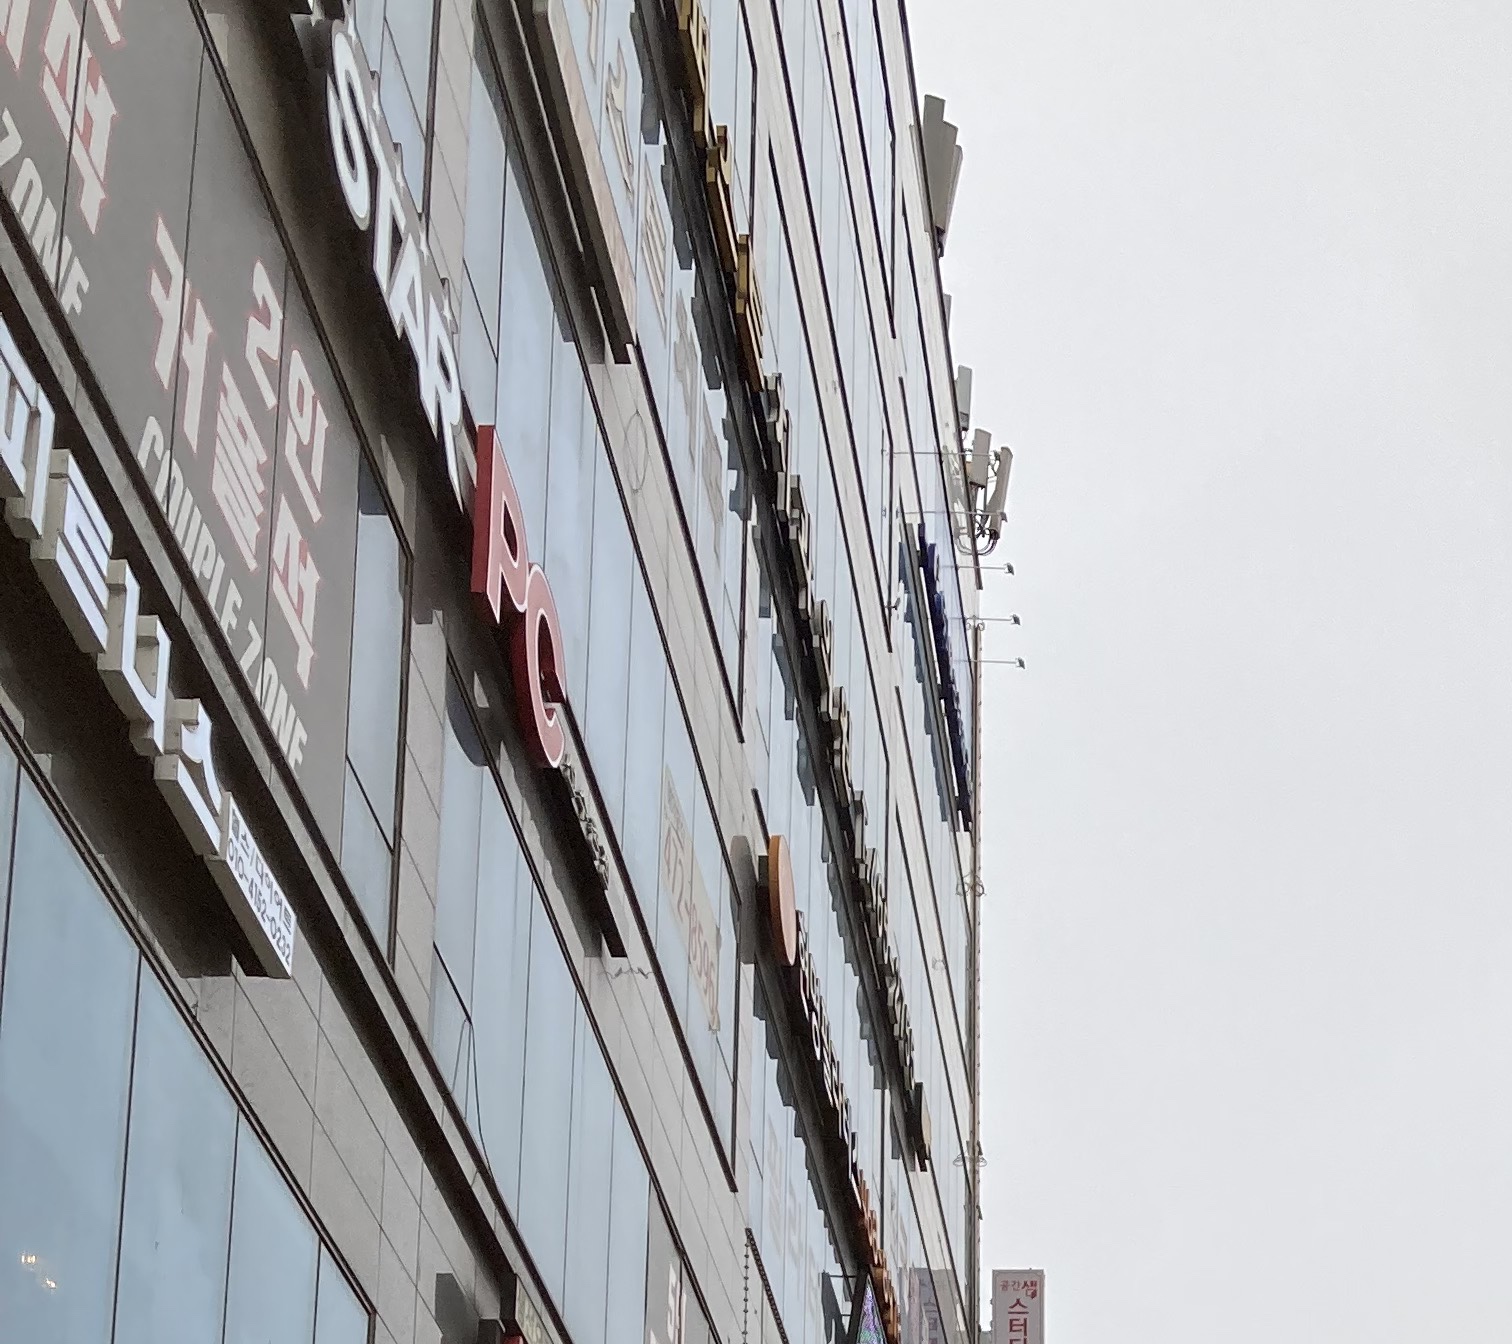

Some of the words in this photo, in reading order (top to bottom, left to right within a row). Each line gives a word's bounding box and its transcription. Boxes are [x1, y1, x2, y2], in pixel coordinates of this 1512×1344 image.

[136, 413, 243, 640] COUPLE
[226, 605, 307, 776] ZONE
[150, 214, 319, 692] 커플석
[245, 258, 329, 524] 2인
[326, 18, 464, 512] STAR
[476, 426, 567, 768] PC
